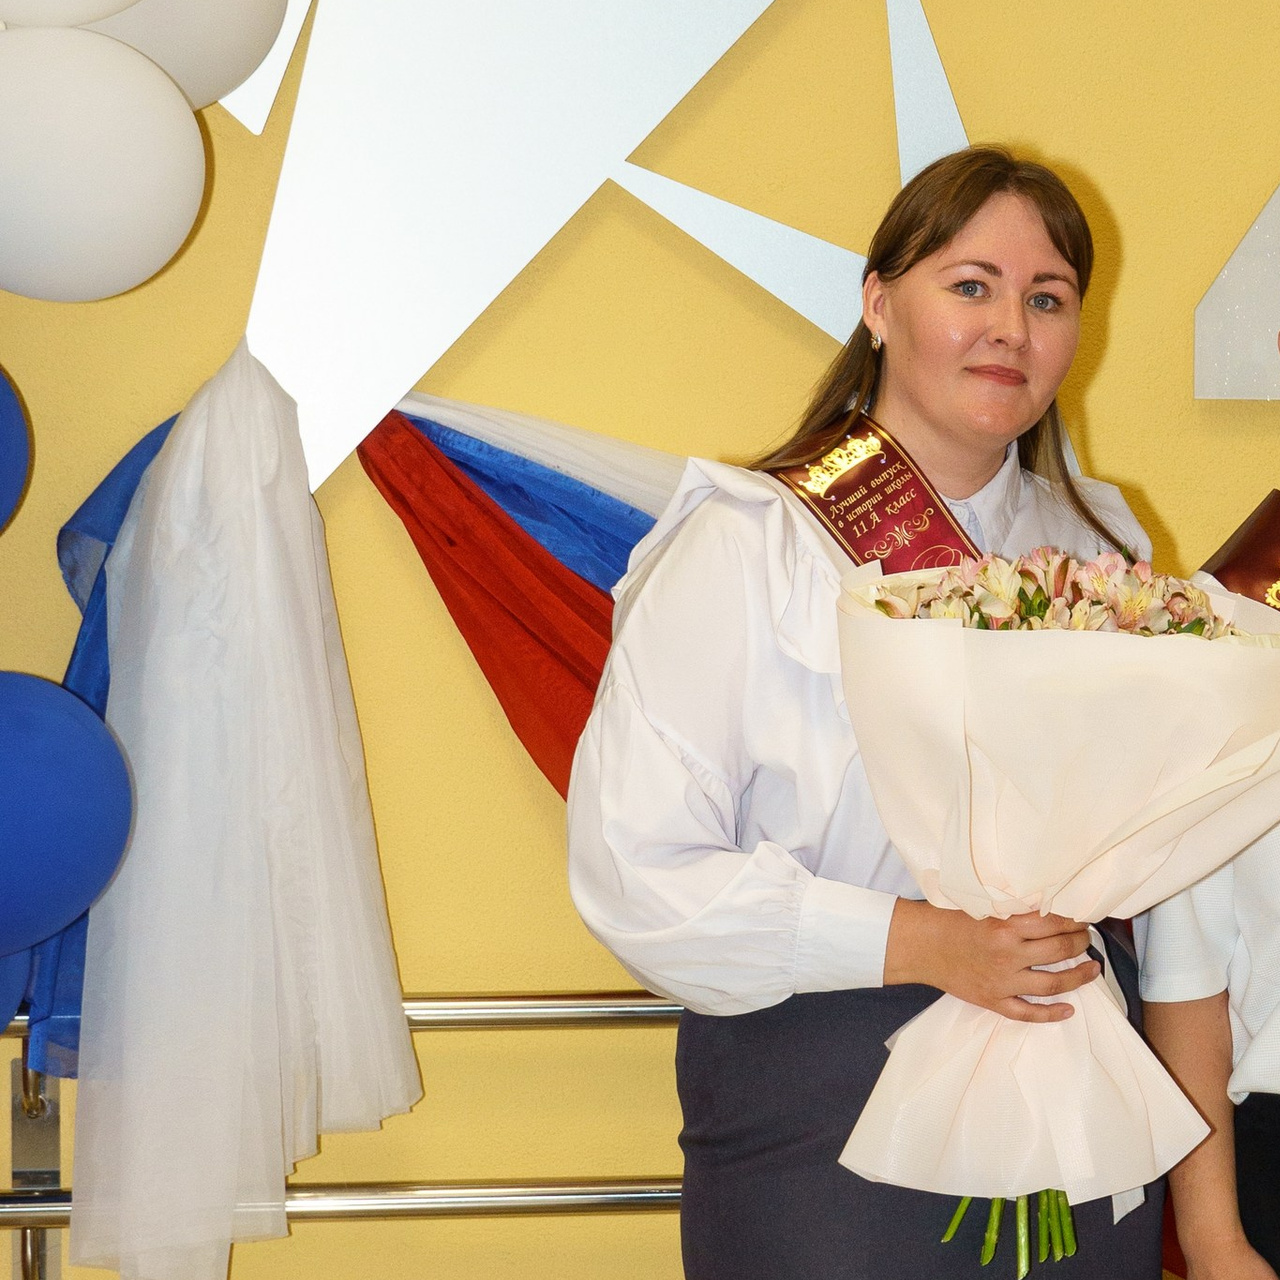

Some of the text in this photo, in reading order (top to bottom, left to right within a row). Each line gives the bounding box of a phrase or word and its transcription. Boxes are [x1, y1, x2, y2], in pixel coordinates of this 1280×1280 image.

[829, 461, 907, 519] Лучший выпуск
[838, 472, 913, 528] в истории школы
[885, 488, 917, 515] класс
